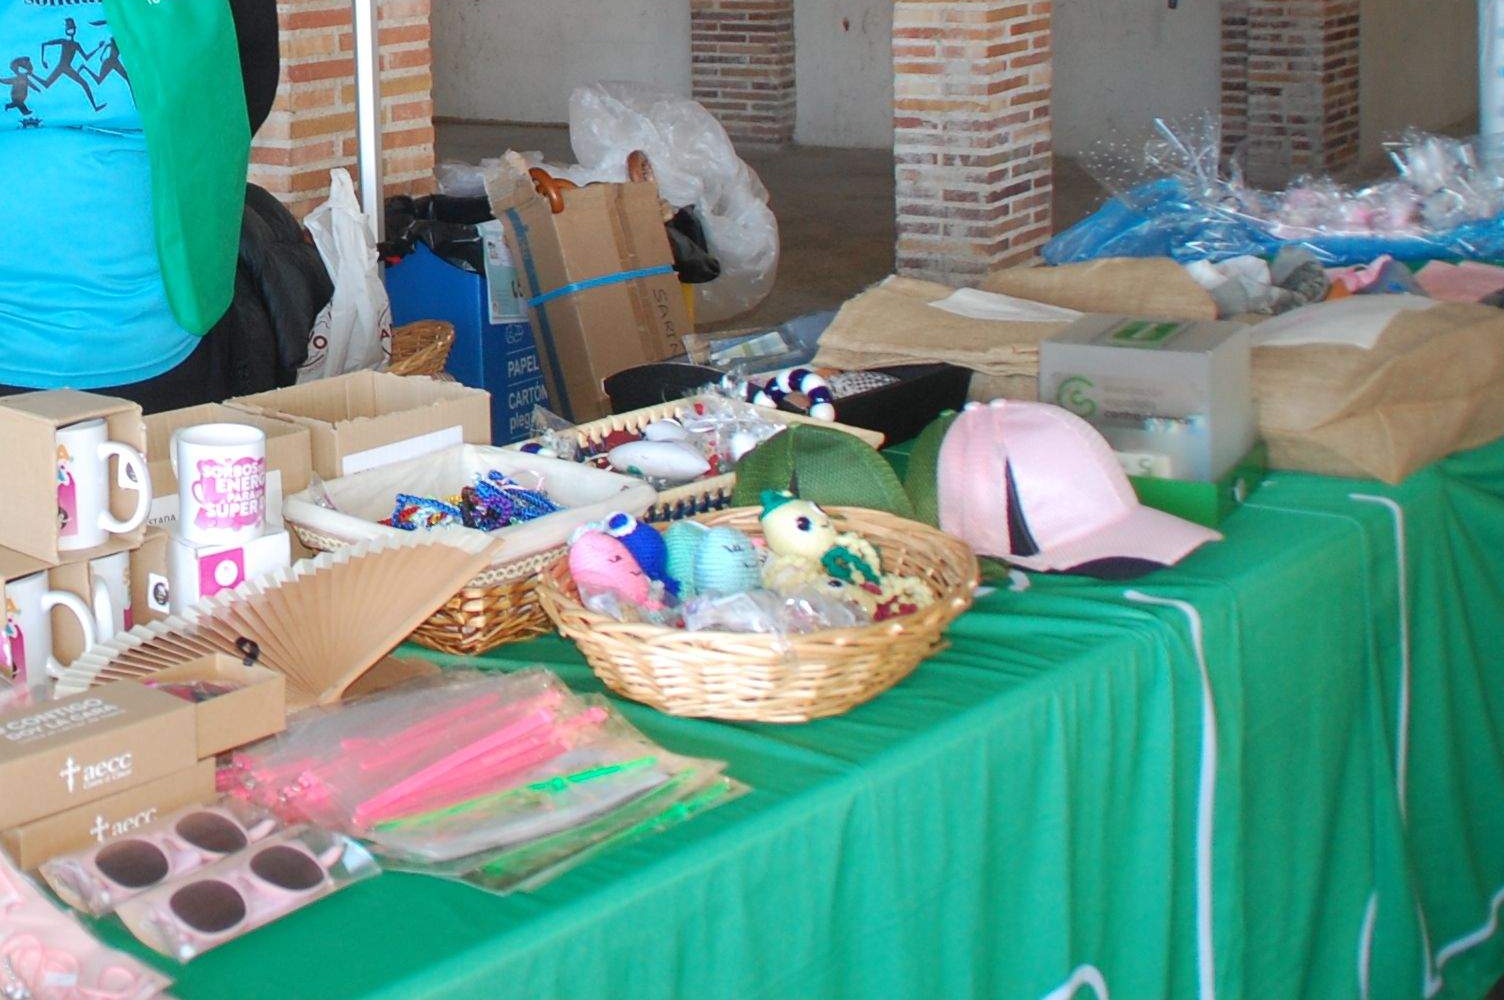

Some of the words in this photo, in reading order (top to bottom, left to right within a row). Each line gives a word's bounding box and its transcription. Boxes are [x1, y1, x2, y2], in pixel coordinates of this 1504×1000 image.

[507, 354, 540, 378] PAPEL
[508, 380, 549, 410] CARTÓN
[206, 499, 258, 518] SUPER
[83, 753, 133, 782] aecc
[111, 807, 158, 837] aecc
